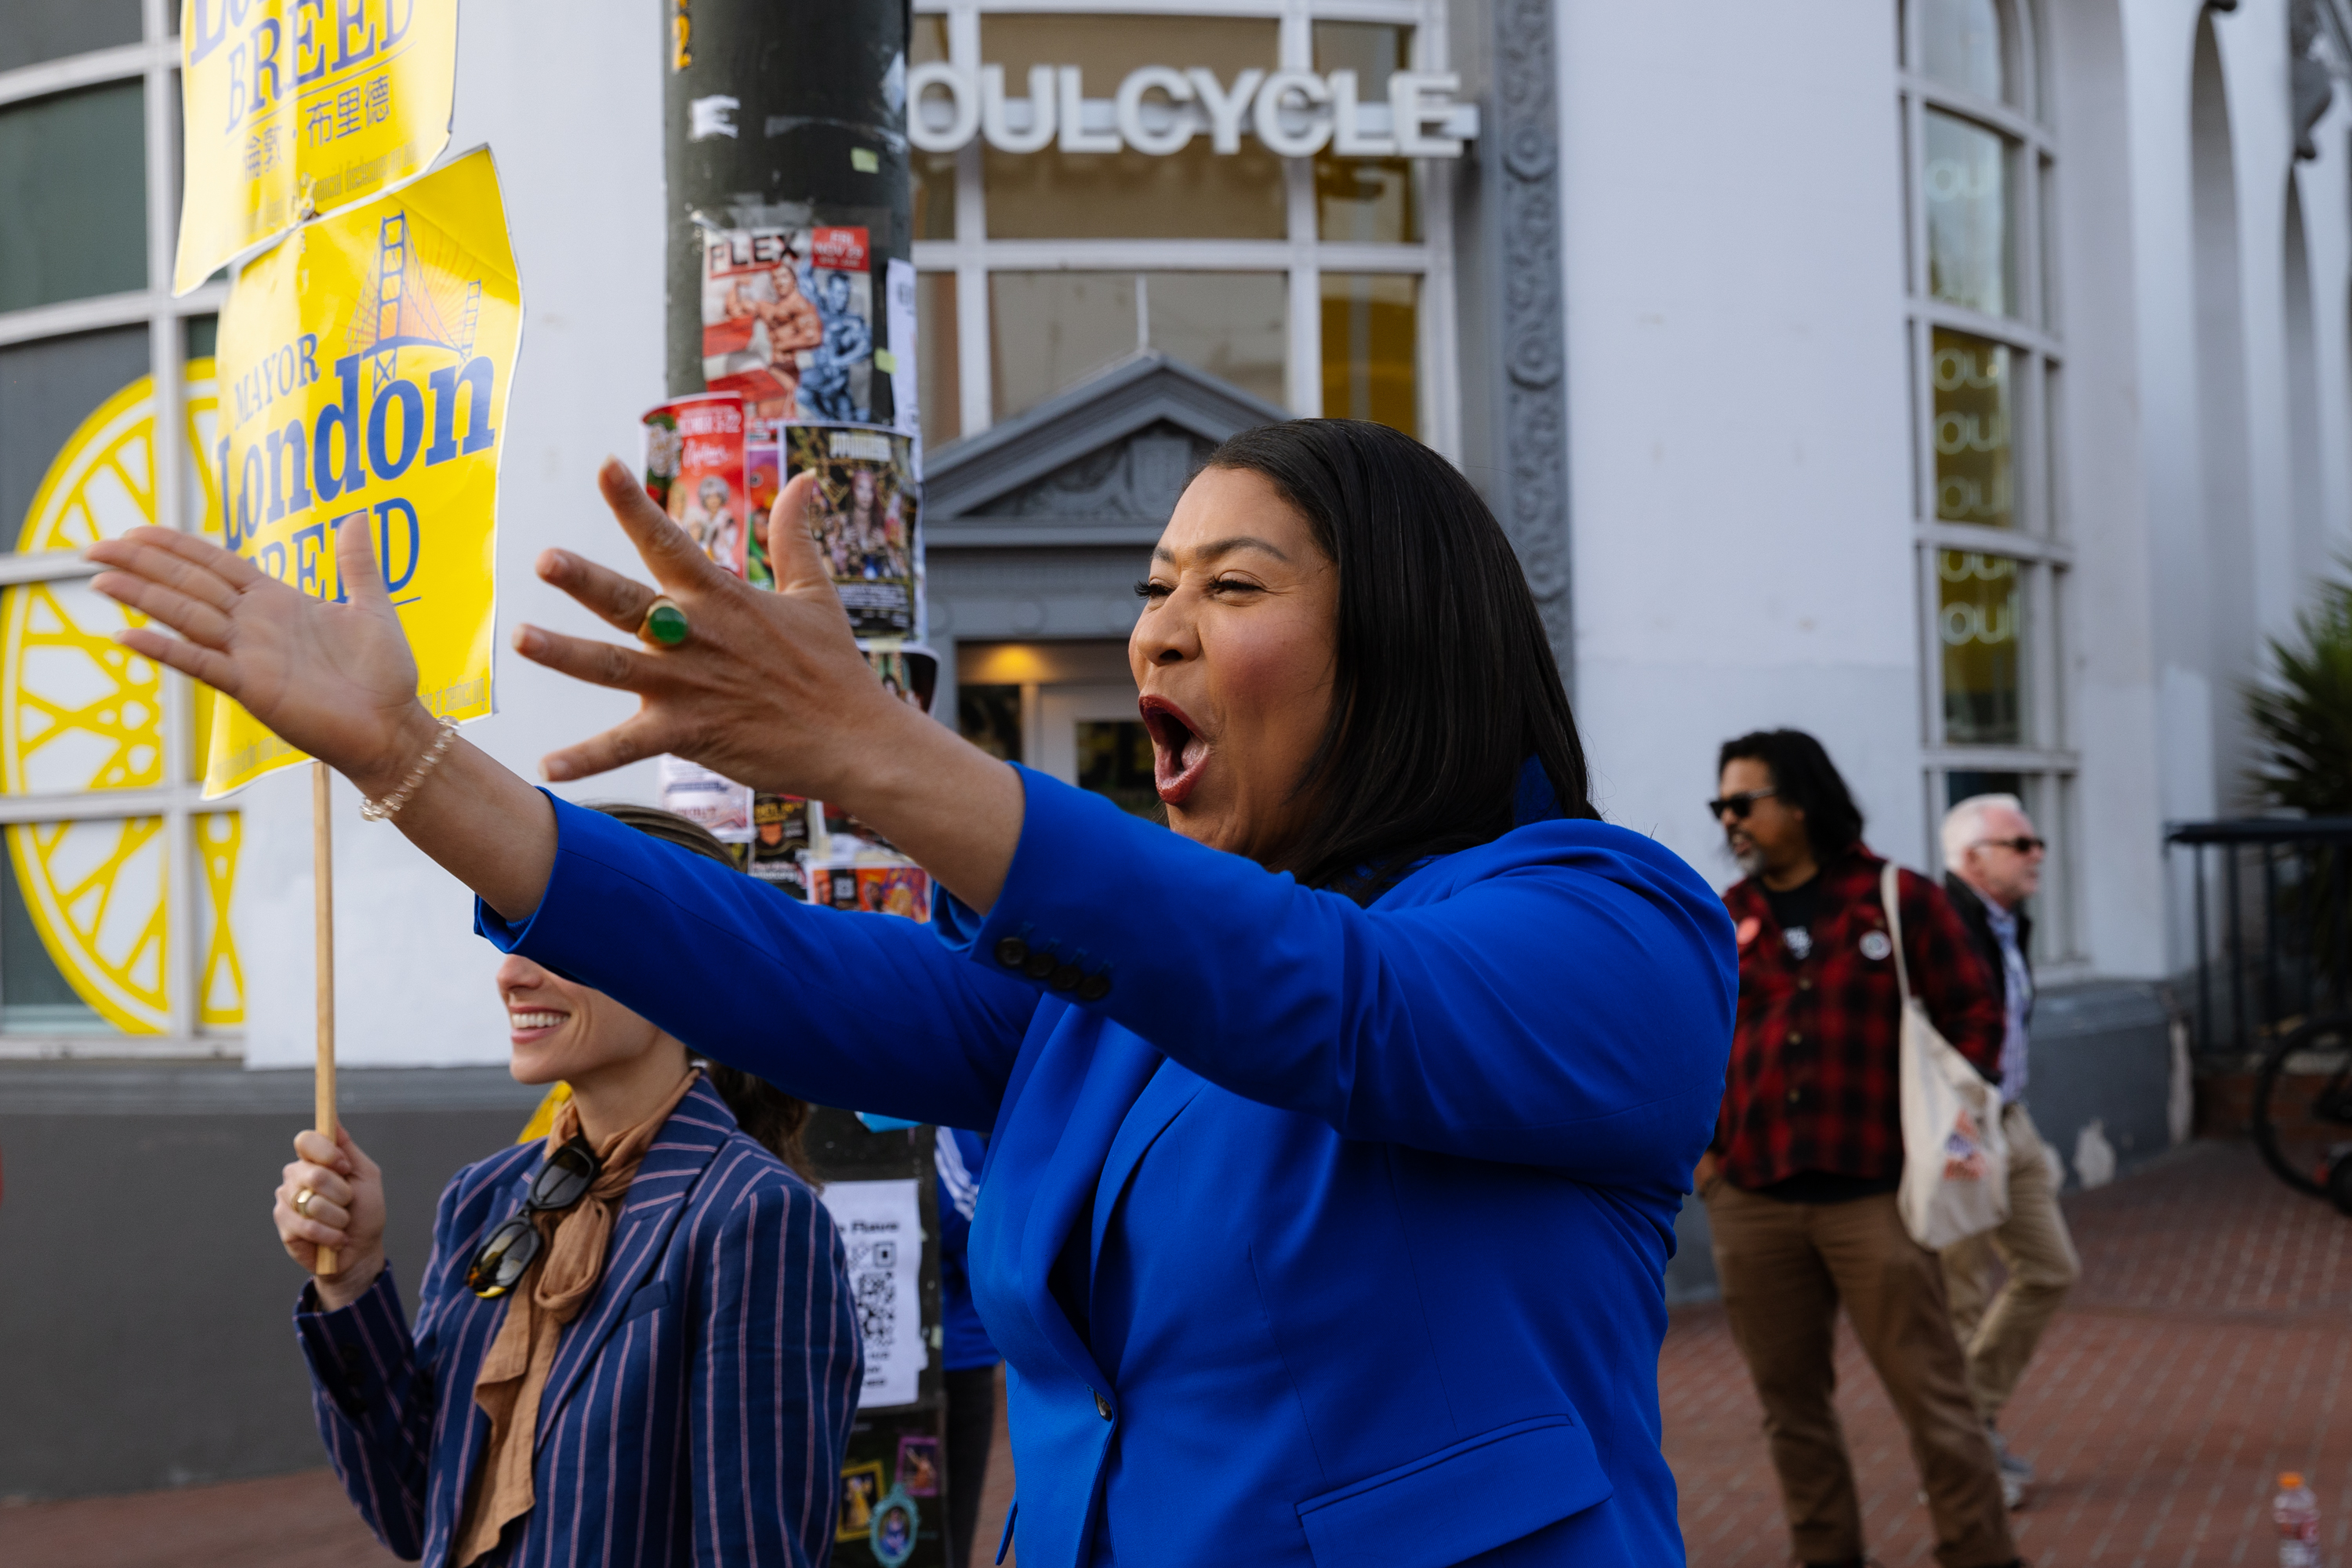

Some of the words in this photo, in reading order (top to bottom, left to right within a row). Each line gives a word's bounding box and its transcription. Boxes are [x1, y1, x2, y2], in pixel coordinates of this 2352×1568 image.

[710, 230, 800, 271] FLEX
[234, 332, 321, 432] MAYOR
[217, 352, 495, 550] London
